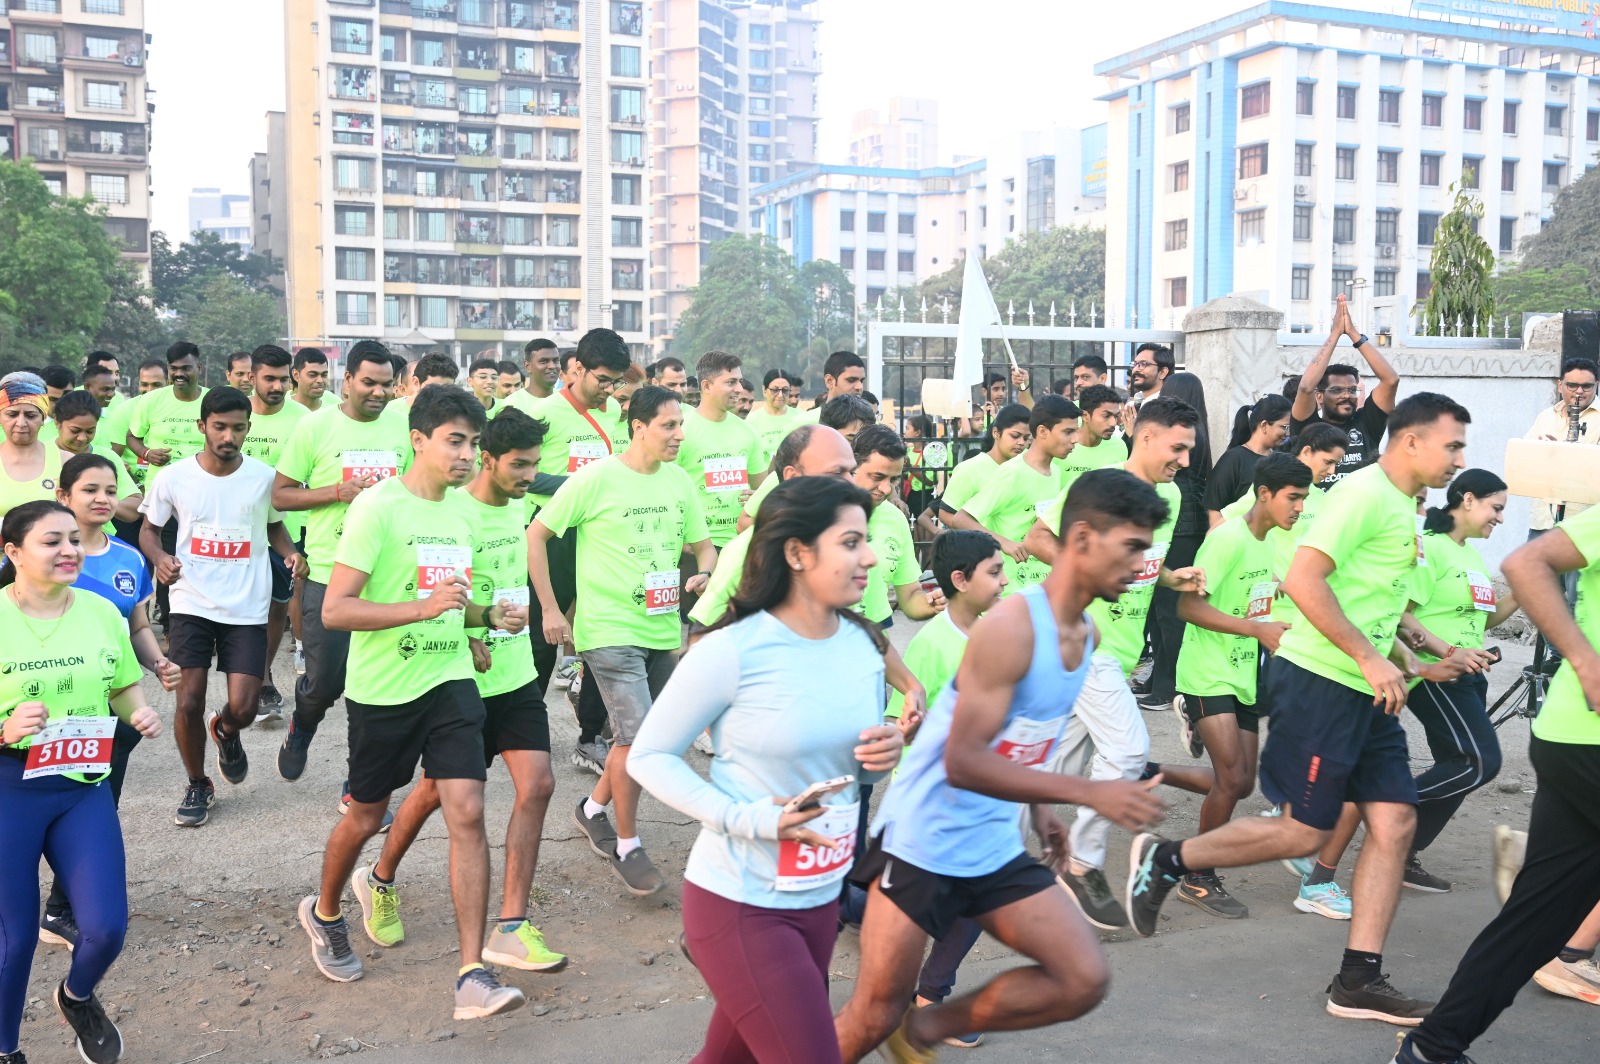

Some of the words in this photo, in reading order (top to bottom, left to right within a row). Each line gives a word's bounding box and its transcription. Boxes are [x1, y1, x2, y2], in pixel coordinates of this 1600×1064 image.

[712, 470, 742, 484] 5044
[632, 506, 668, 515] DECATHLON
[417, 536, 457, 545] DECATHLON
[487, 536, 520, 550] DECATHLON
[200, 540, 244, 556] 5117
[1474, 586, 1492, 602] 5029
[422, 640, 447, 651] JANYA
[19, 656, 85, 671] DECATHLON
[38, 739, 99, 763] 5108
